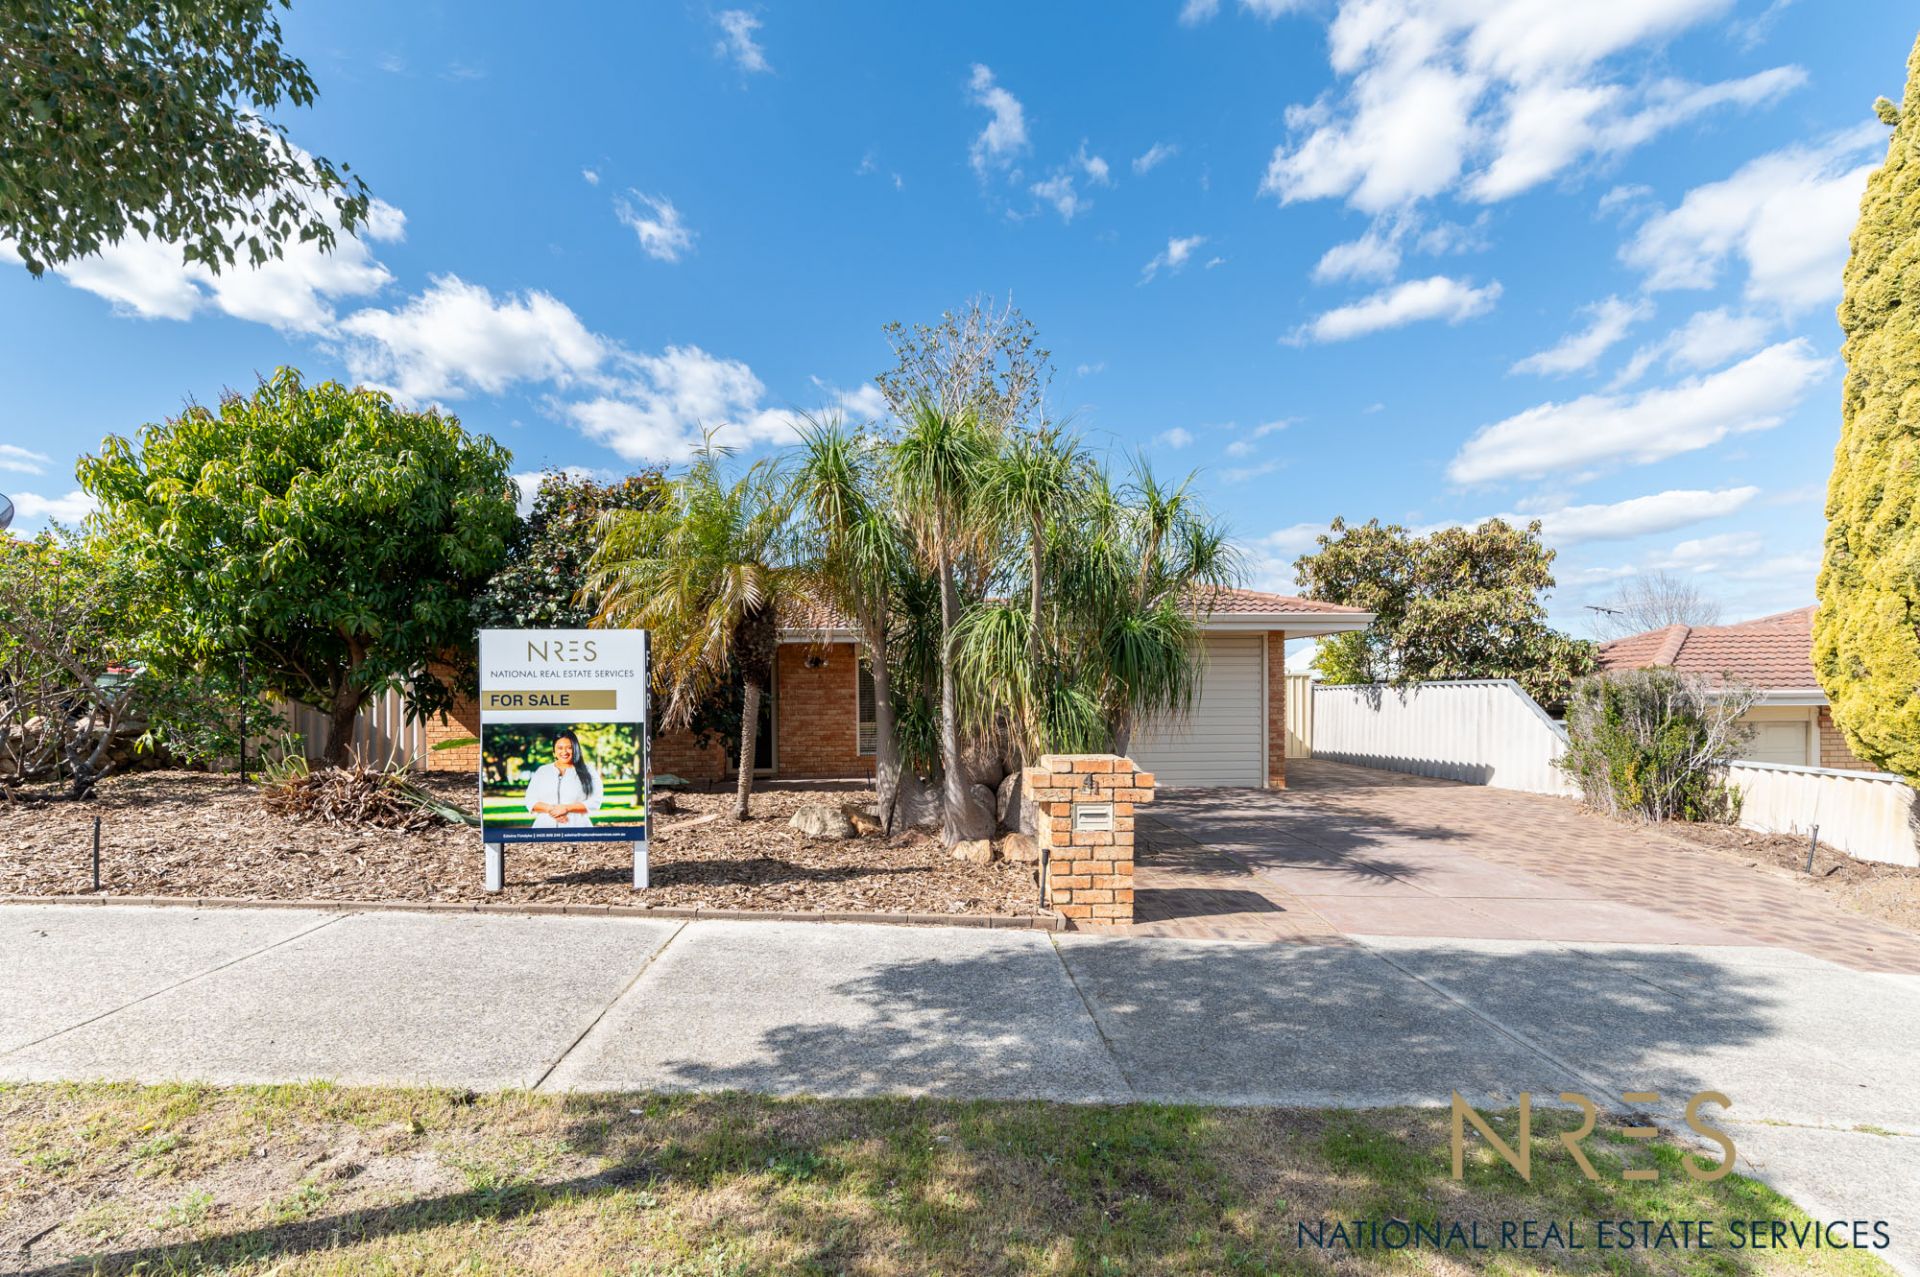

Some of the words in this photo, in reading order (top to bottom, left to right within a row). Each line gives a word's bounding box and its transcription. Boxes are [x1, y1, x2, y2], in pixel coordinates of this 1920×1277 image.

[528, 640, 597, 662] NRES
[490, 670, 537, 678] NATIONAL
[540, 670, 560, 678] REAL
[563, 670, 592, 678] ESTATE
[595, 669, 634, 678] SERVICES
[491, 695, 523, 706] FOR
[528, 694, 570, 706] SALE
